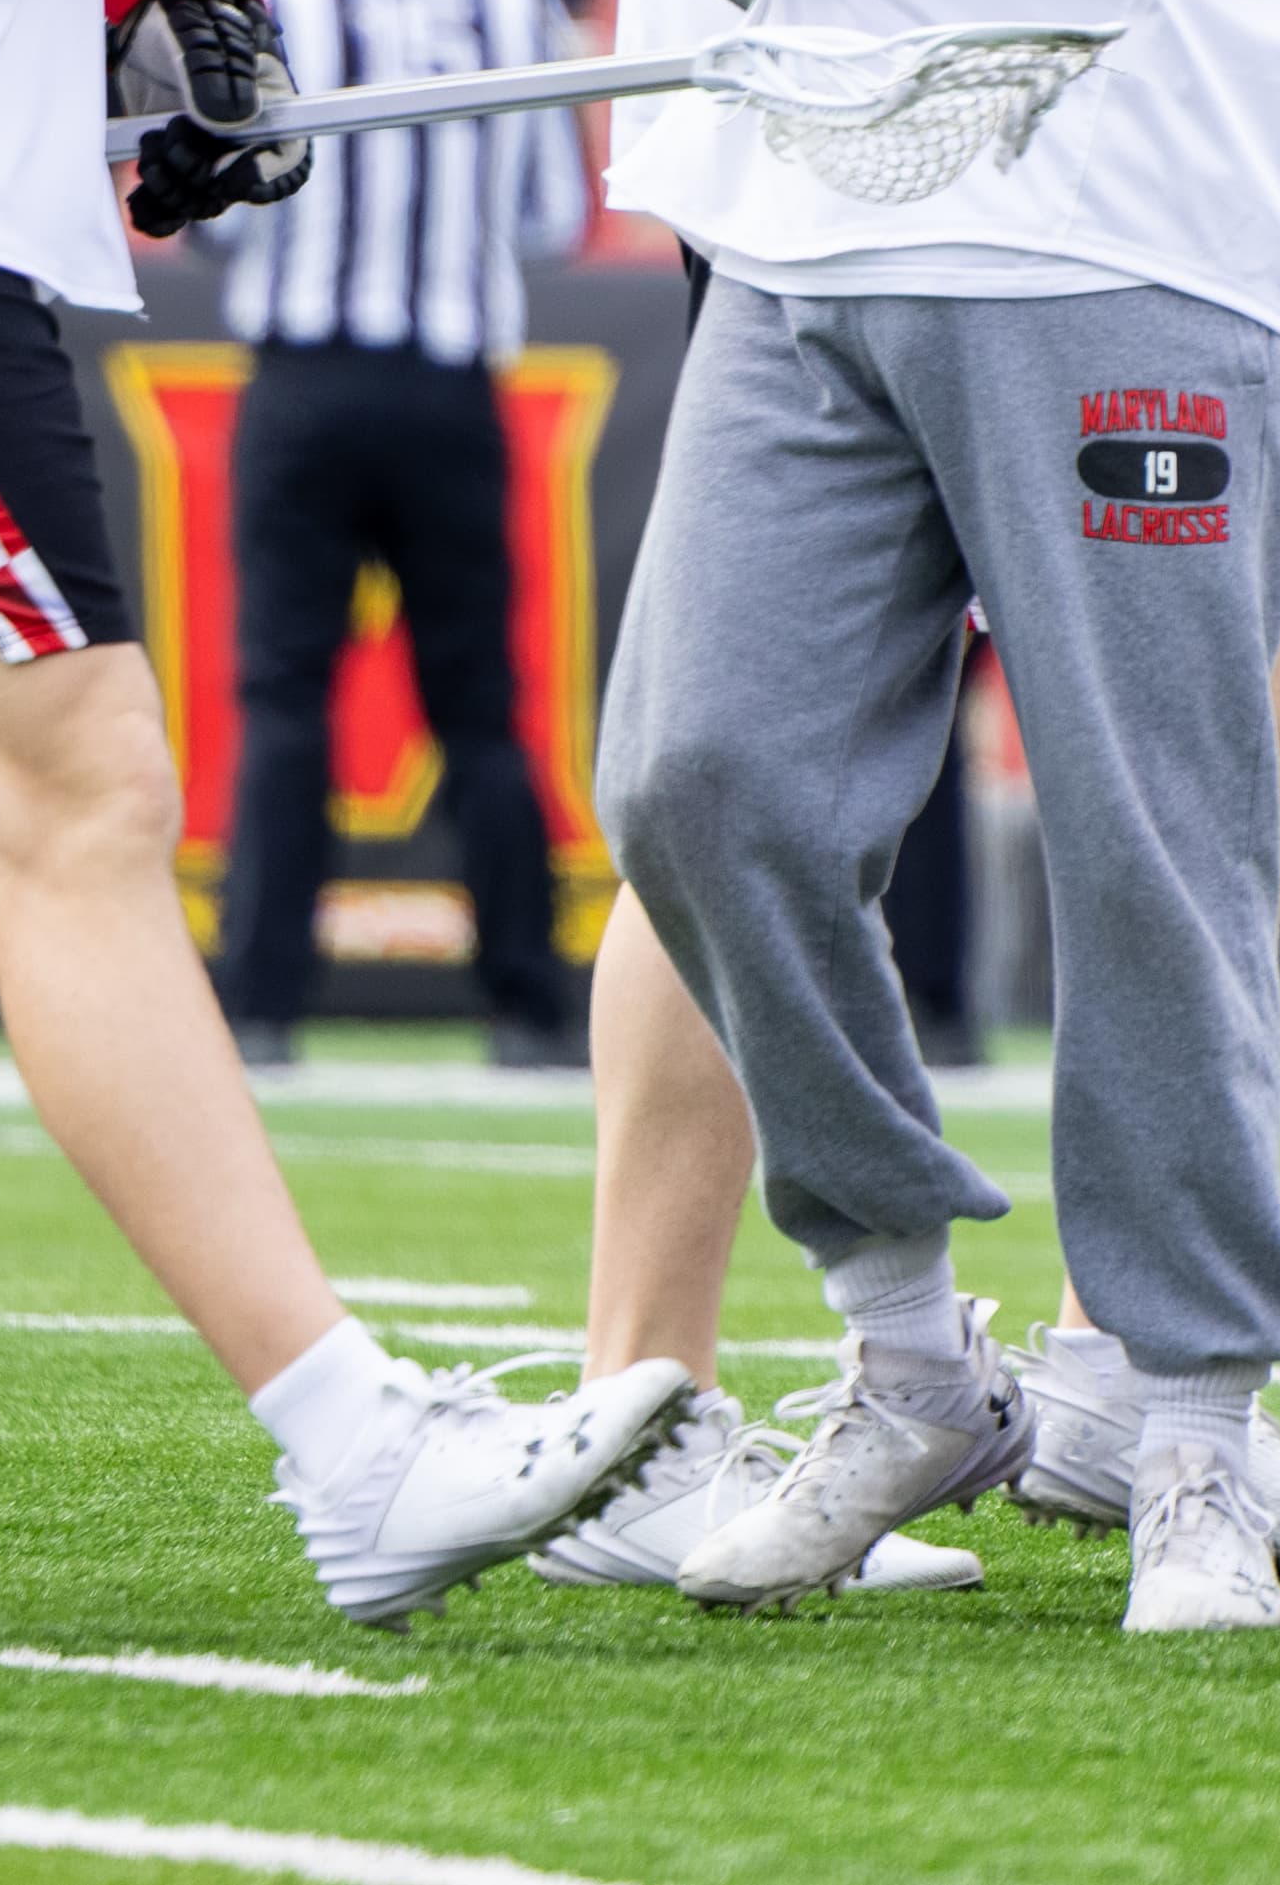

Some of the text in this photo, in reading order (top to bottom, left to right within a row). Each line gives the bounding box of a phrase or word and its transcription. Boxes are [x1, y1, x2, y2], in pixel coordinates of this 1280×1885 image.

[1080, 388, 1227, 441] MARYLAND
[1143, 450, 1178, 495] 19
[1082, 500, 1230, 546] LACROSSE
